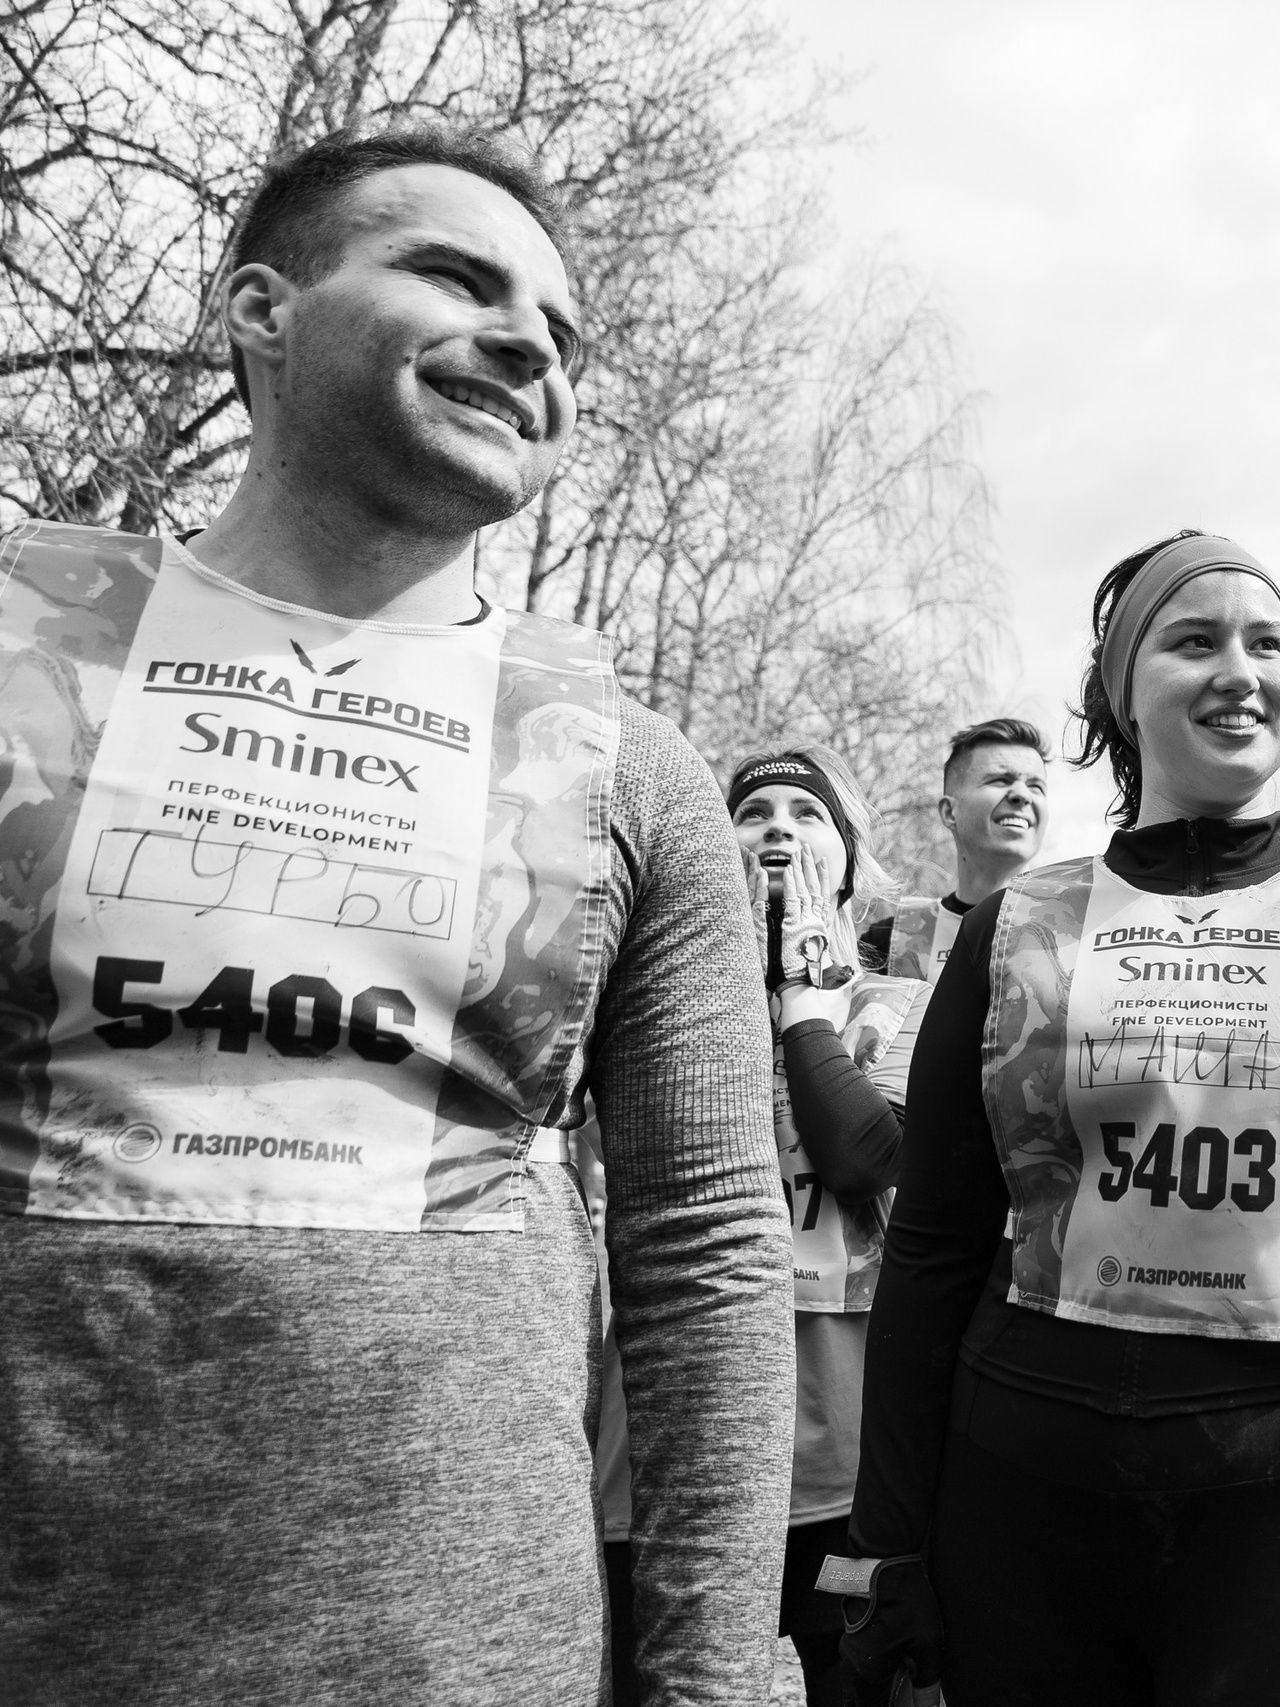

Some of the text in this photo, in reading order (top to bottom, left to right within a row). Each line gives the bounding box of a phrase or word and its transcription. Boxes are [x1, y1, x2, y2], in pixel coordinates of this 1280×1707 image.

[145, 660, 471, 743] ГОНКА ГЕРОЕВ
[178, 711, 420, 794] Sminex
[167, 779, 417, 832] ПЕРФЕКЦИОНИСТЫ
[161, 804, 413, 855] FINE DEVELOPMENT
[1094, 926, 1184, 946] ГОНКА
[1117, 956, 1268, 985] Sminex
[1112, 1016, 1268, 1029] FINE DEVELOPMENT
[1113, 999, 1268, 1012] ПЕРФЕКЦИОНИСТЫ
[171, 1132, 364, 1166] ГАЗПРОМБАНК
[1097, 1121, 1277, 1213] 5403
[1127, 1265, 1247, 1291] ГАЗПРОМБАНК
